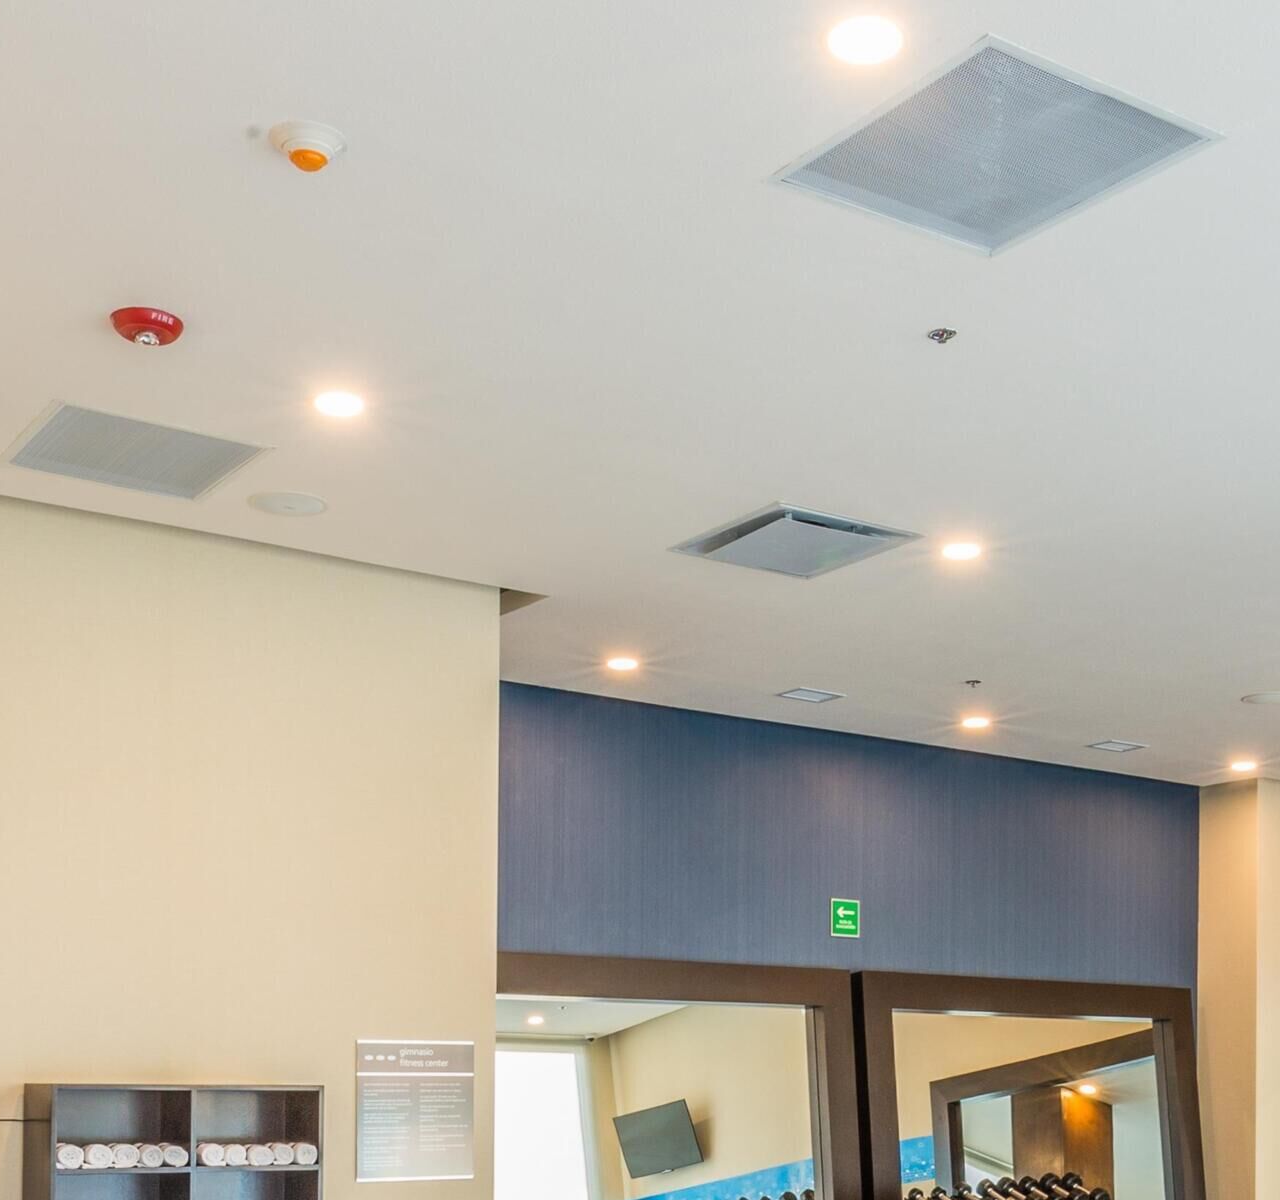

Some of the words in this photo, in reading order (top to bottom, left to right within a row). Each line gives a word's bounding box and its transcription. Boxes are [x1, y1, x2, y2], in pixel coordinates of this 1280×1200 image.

[151, 311, 175, 325] FIRE
[400, 1047, 434, 1057] gimnasio
[400, 1058, 424, 1067] fitness
[425, 1059, 449, 1067] center
